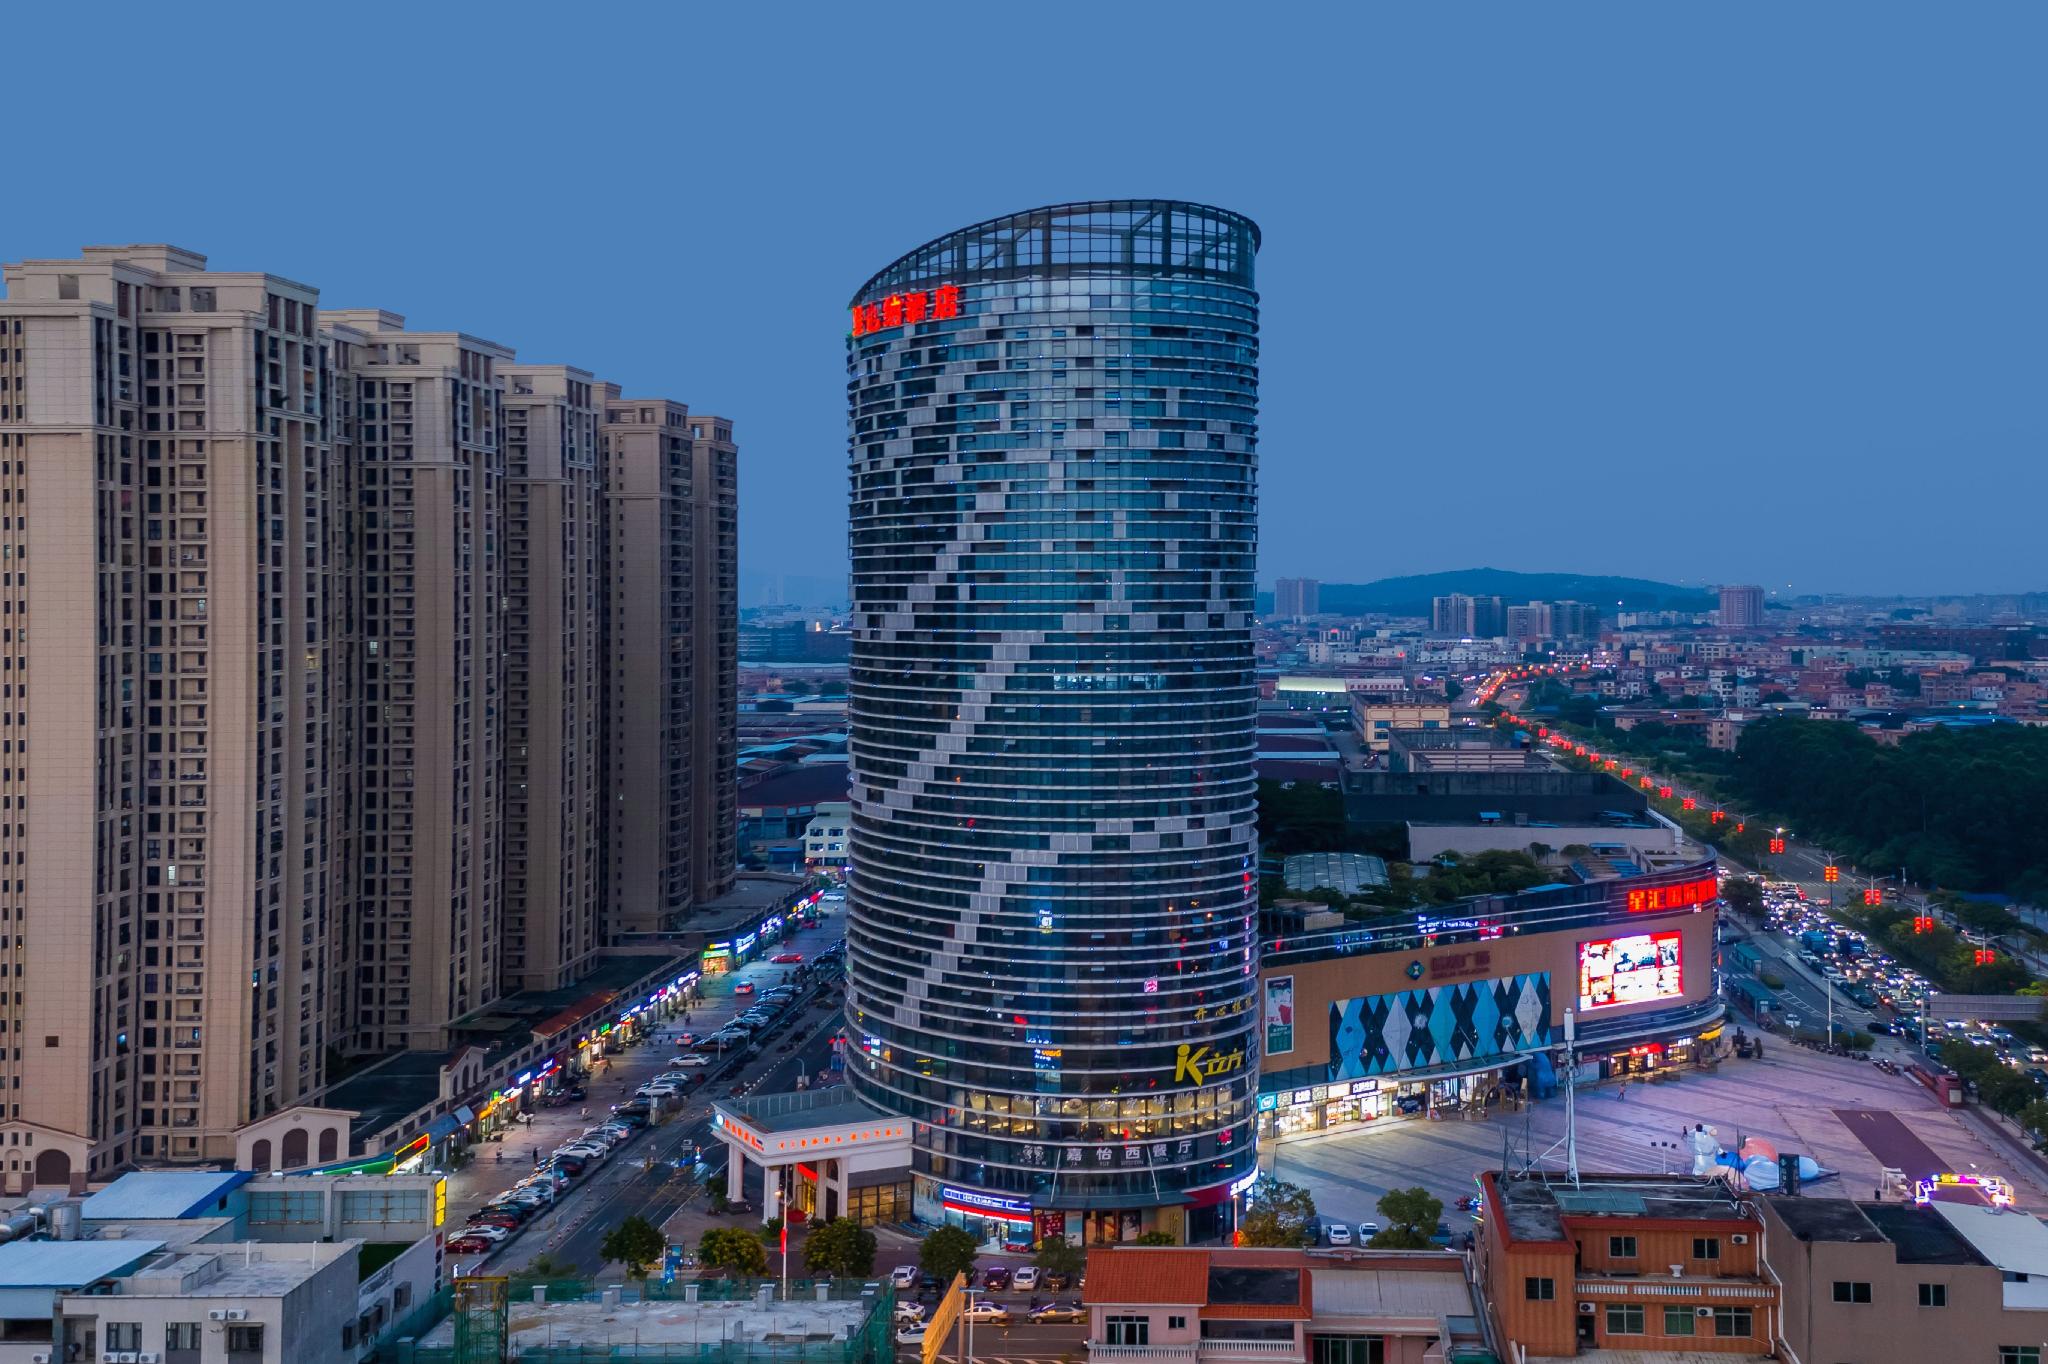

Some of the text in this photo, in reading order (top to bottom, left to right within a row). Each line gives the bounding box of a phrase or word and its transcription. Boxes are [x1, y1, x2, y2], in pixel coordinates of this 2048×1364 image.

[1067, 1141, 1192, 1161] 嘉怡西餐厅
